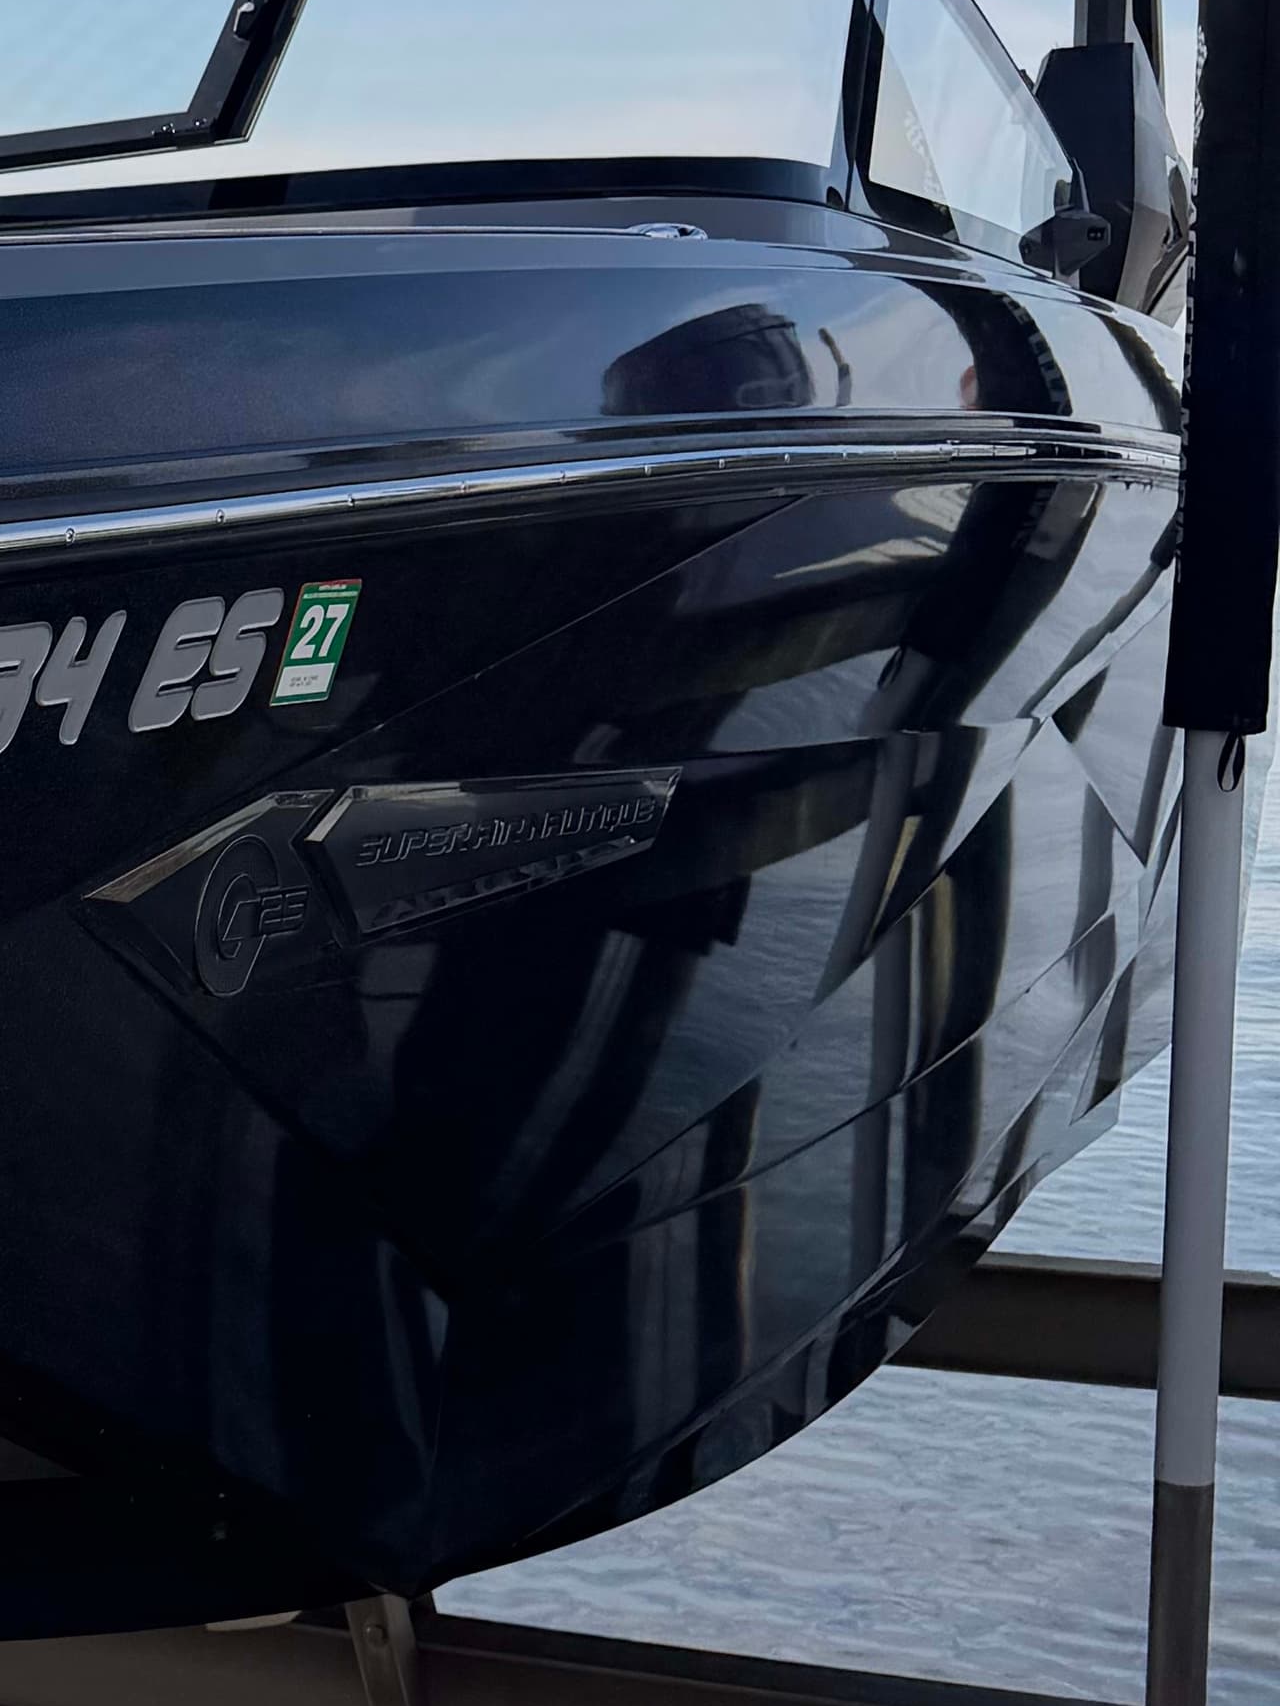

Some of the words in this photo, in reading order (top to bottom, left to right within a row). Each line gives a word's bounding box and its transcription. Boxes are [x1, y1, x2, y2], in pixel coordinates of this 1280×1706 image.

[290, 603, 350, 660] 27
[127, 587, 285, 734] ES
[354, 822, 473, 867] SUPER
